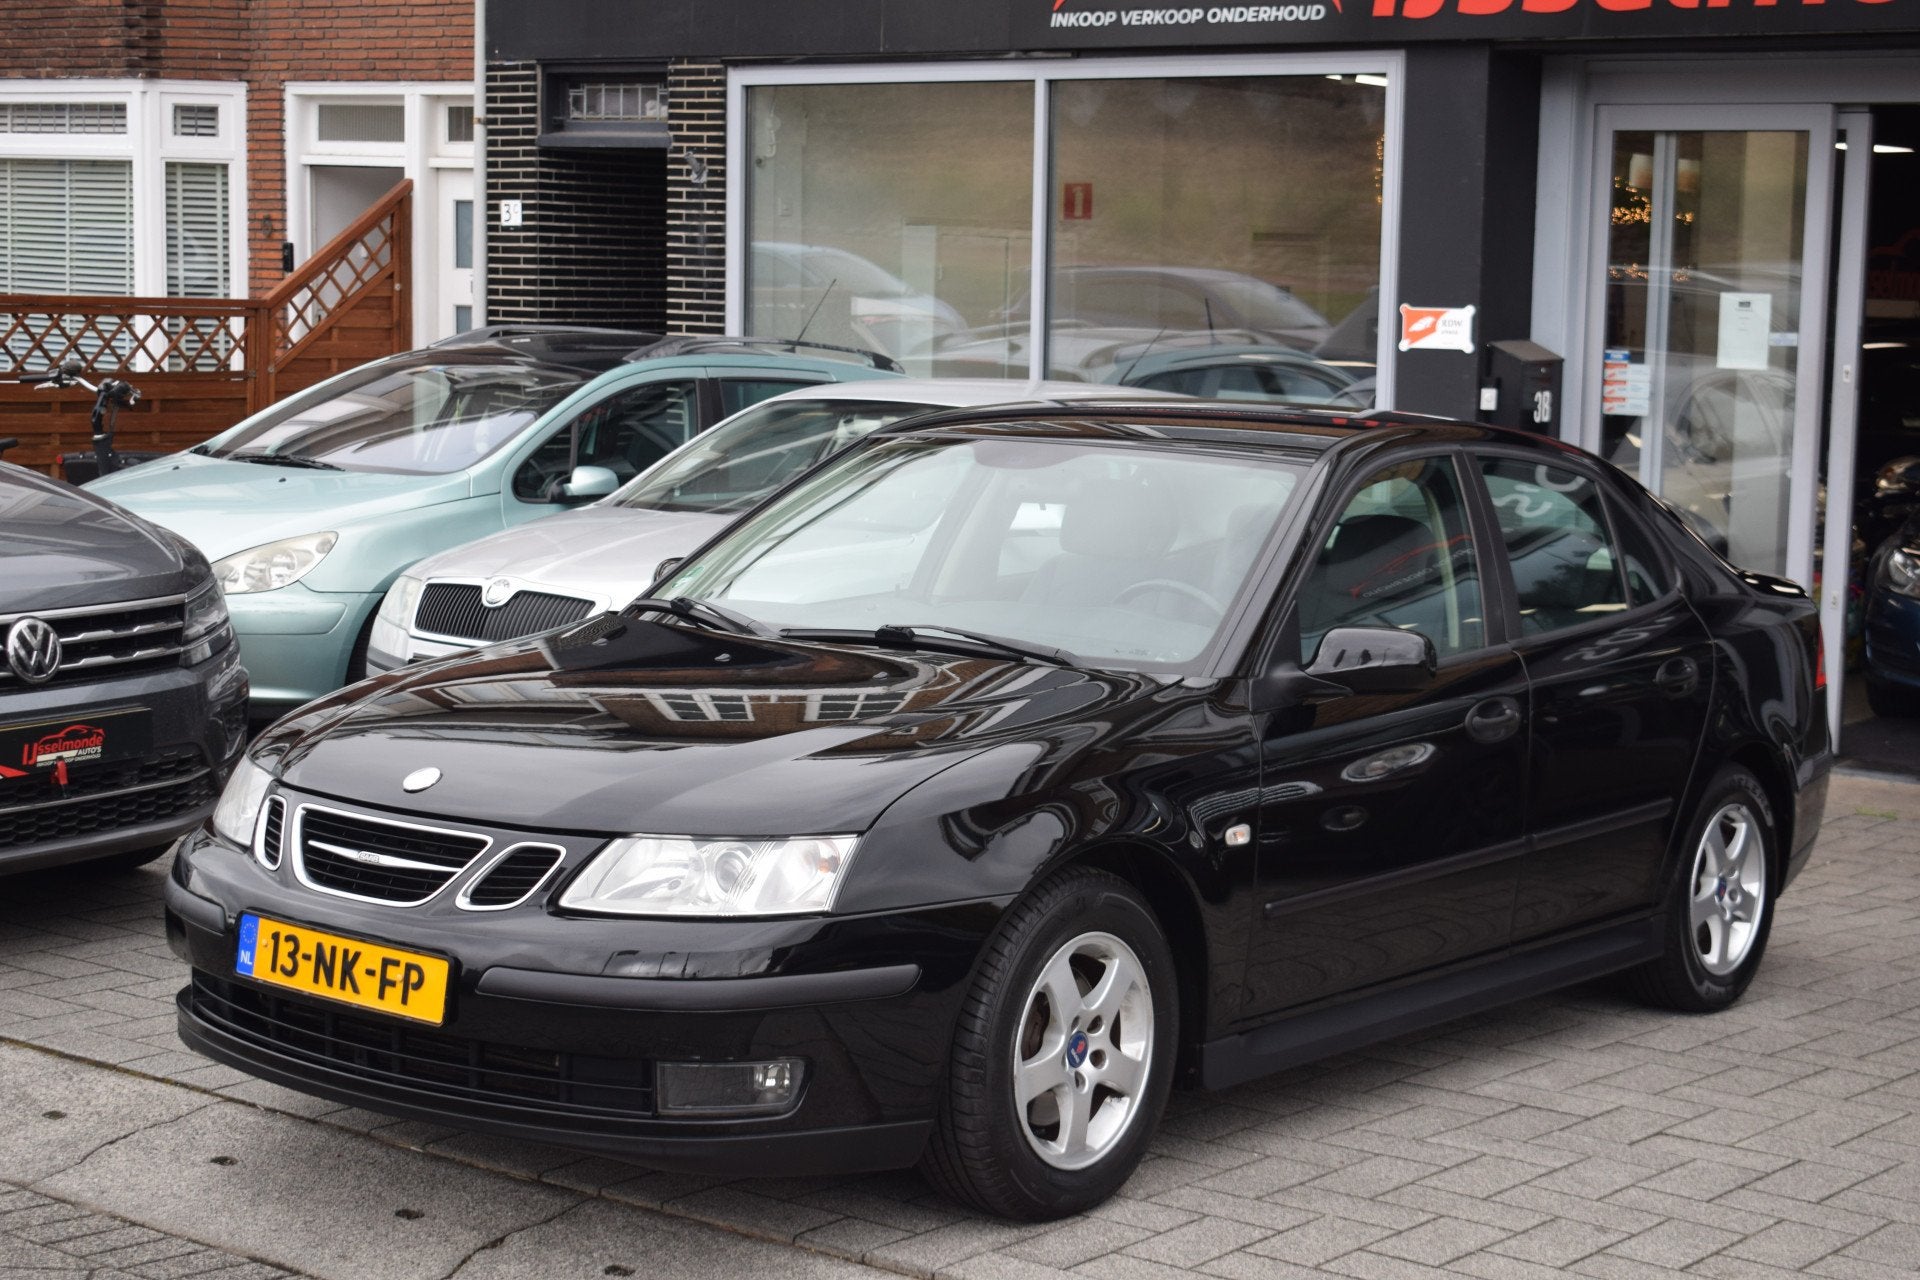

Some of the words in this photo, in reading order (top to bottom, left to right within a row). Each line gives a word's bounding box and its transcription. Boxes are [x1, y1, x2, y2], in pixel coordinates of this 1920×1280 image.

[1050, 11, 1117, 28] INKOOP
[1120, 9, 1204, 26] VERKOOP
[1207, 5, 1326, 24] ONDERHOUD
[78, 746, 102, 756] AUTO'S
[240, 950, 252, 965] NL
[270, 930, 425, 1006] 13-NK-FP
